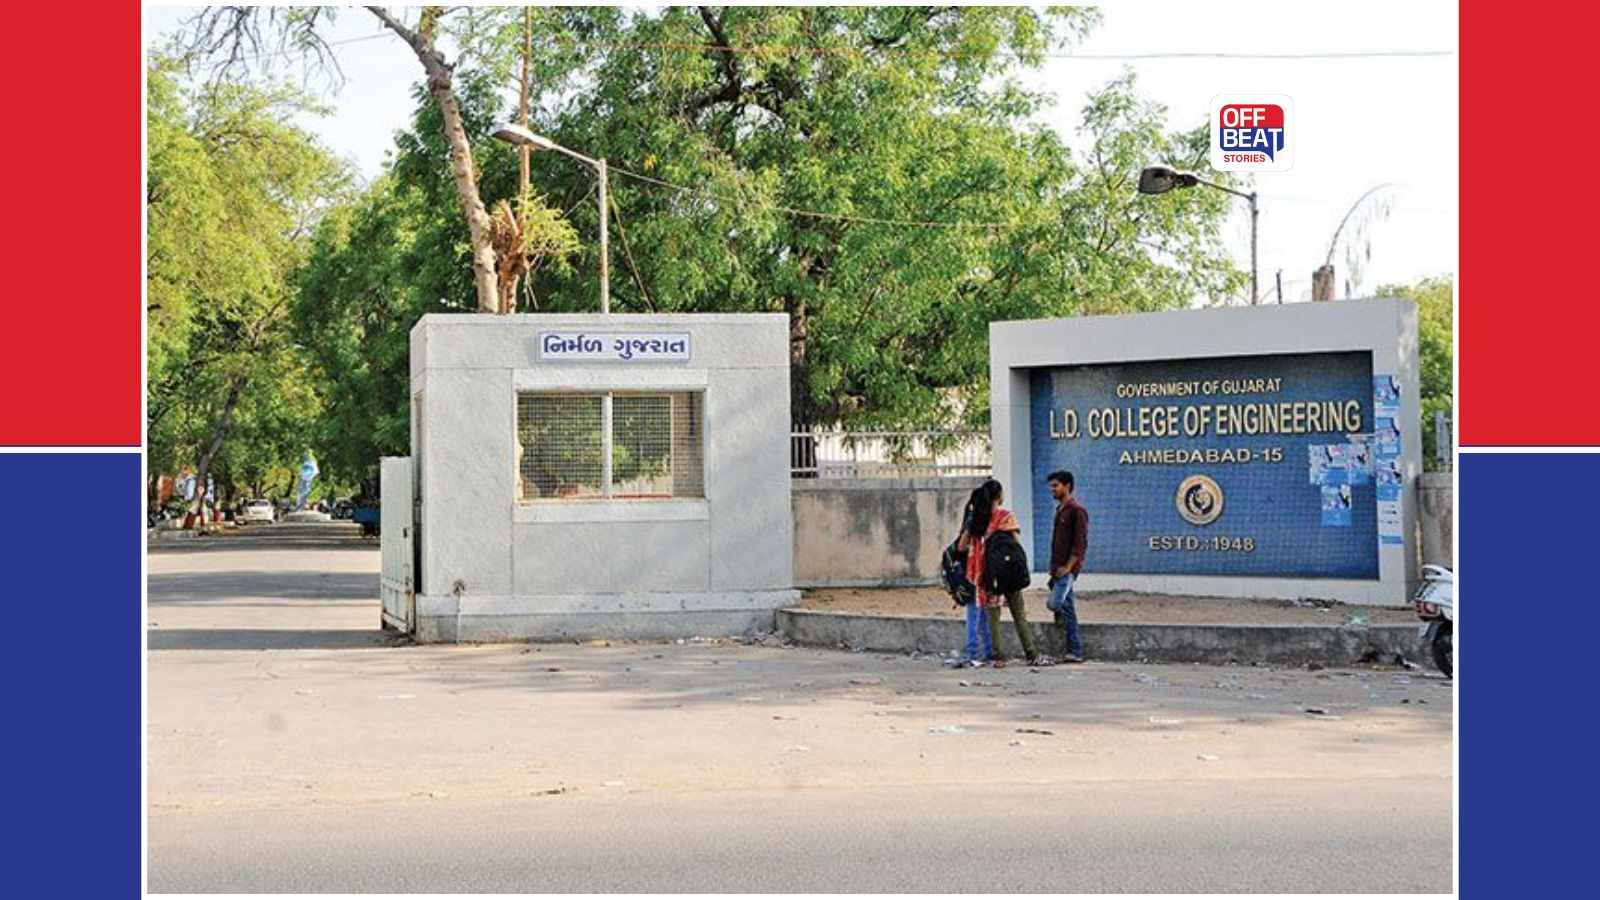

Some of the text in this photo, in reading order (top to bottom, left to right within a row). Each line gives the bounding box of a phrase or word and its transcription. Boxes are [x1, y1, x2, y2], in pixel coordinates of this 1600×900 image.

[543, 334, 686, 361] નિર્મળ ગુજરાત
[1116, 377, 1282, 398] GOVERNMENT OF GUJARAT
[1049, 399, 1362, 439] L.D. COLLEGE OF ENGINEERING
[1119, 447, 1284, 465] AHMEDABAD-15
